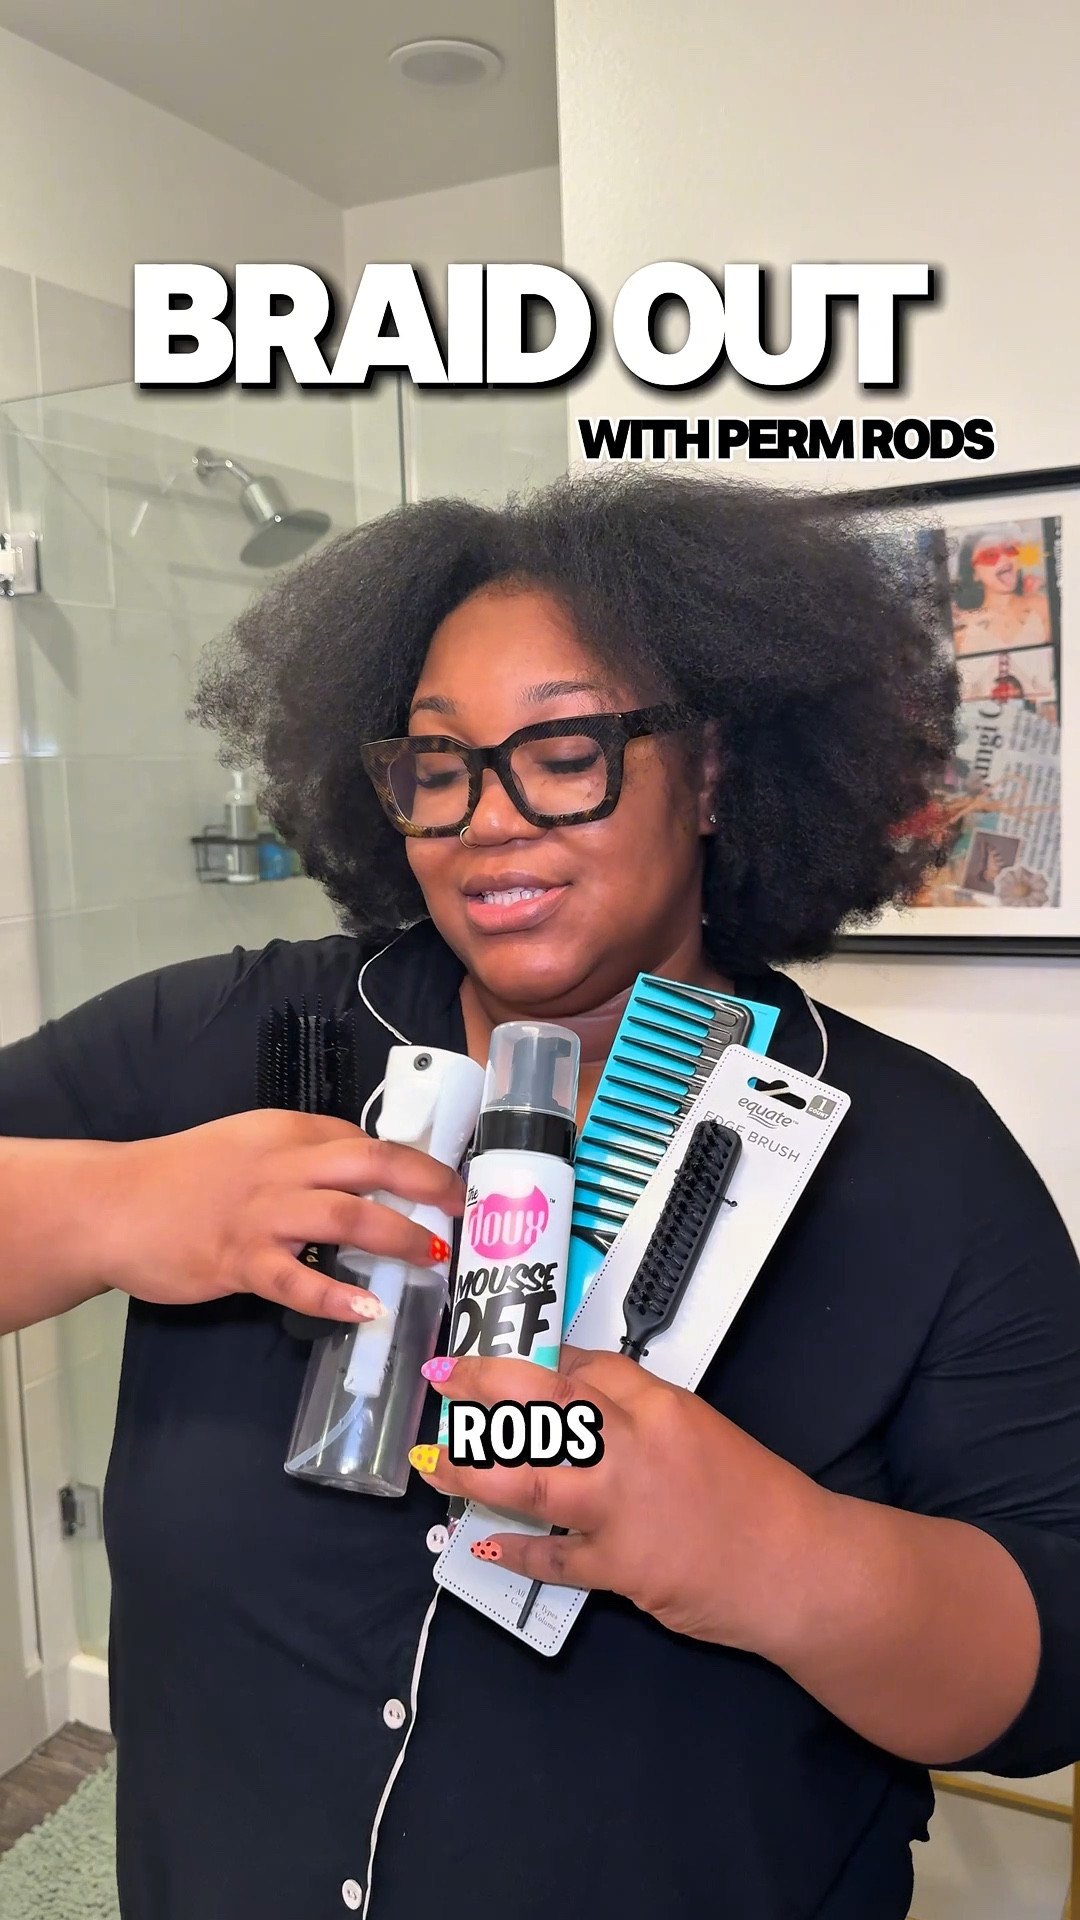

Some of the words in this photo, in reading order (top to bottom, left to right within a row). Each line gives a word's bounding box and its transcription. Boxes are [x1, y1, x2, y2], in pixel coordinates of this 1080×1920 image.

[737, 1097, 793, 1128] equate
[809, 1107, 829, 1119] COUNT
[817, 1099, 828, 1112] 1
[703, 1110, 746, 1133] EDGE
[746, 1131, 801, 1163] BRUSH
[469, 1201, 545, 1247] doux
[456, 1262, 559, 1302] MOUSSE
[451, 1290, 558, 1357] DEF
[534, 1612, 557, 1631] Volume
